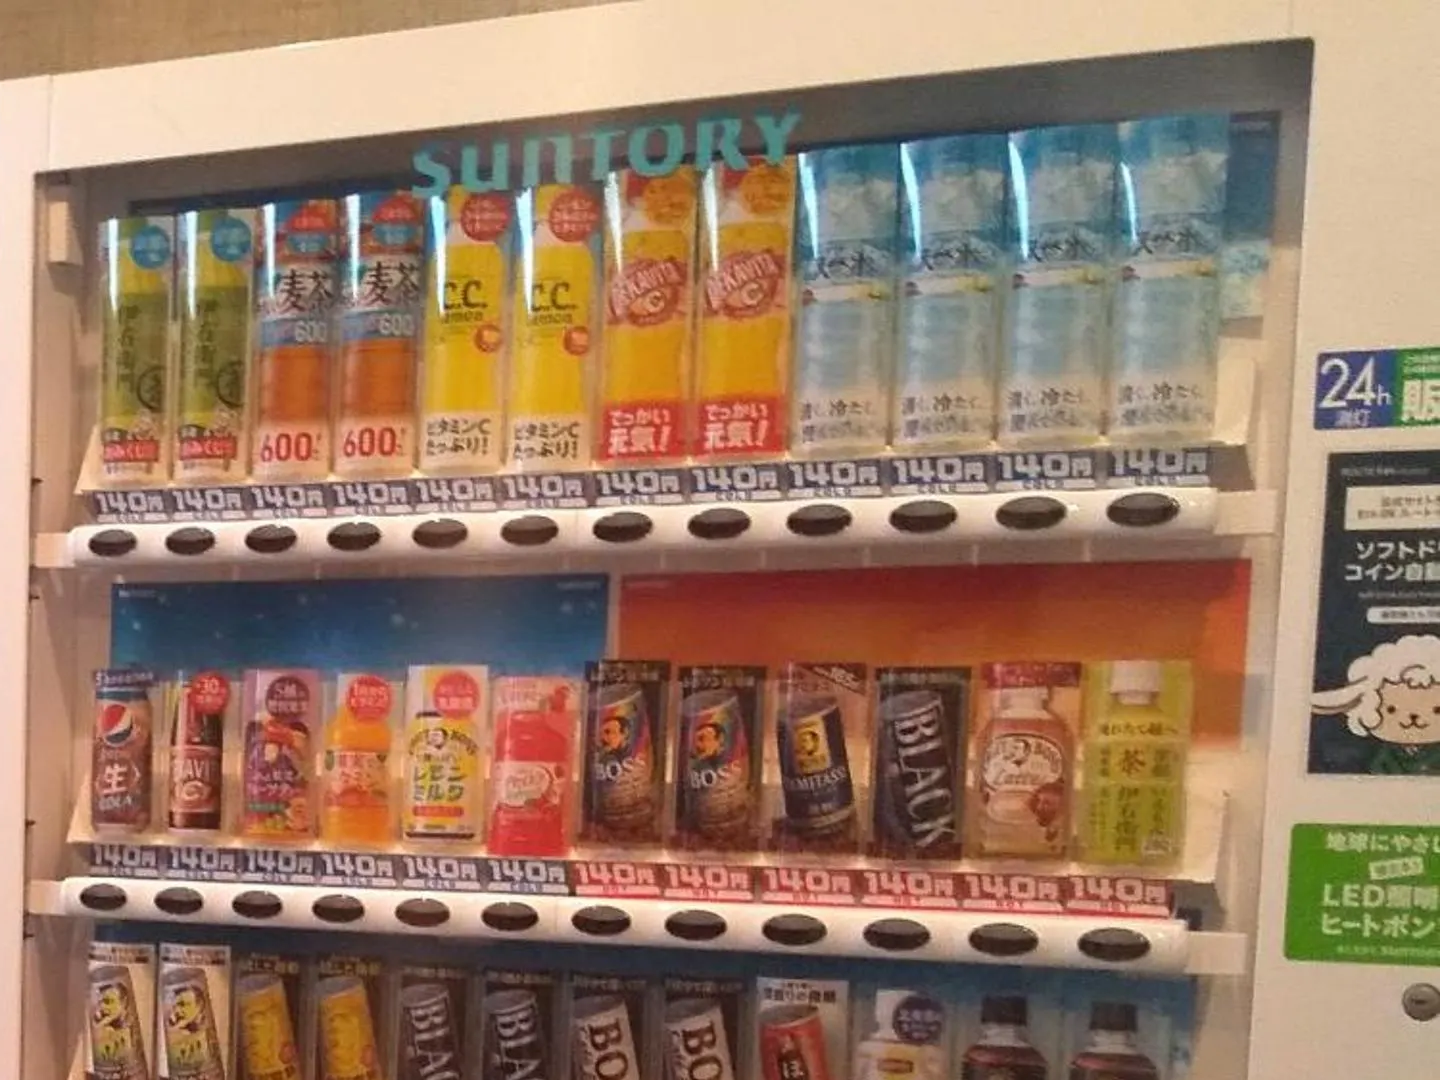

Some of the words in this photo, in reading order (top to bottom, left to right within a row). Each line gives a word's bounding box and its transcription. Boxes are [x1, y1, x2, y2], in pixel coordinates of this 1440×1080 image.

[1319, 357, 1392, 408] 24h
[1356, 540, 1440, 560] ソフトド
[595, 756, 647, 781] BOSS
[689, 760, 742, 789] BOSS
[893, 698, 958, 849] BLACK
[1322, 912, 1440, 938] ヒートポン
